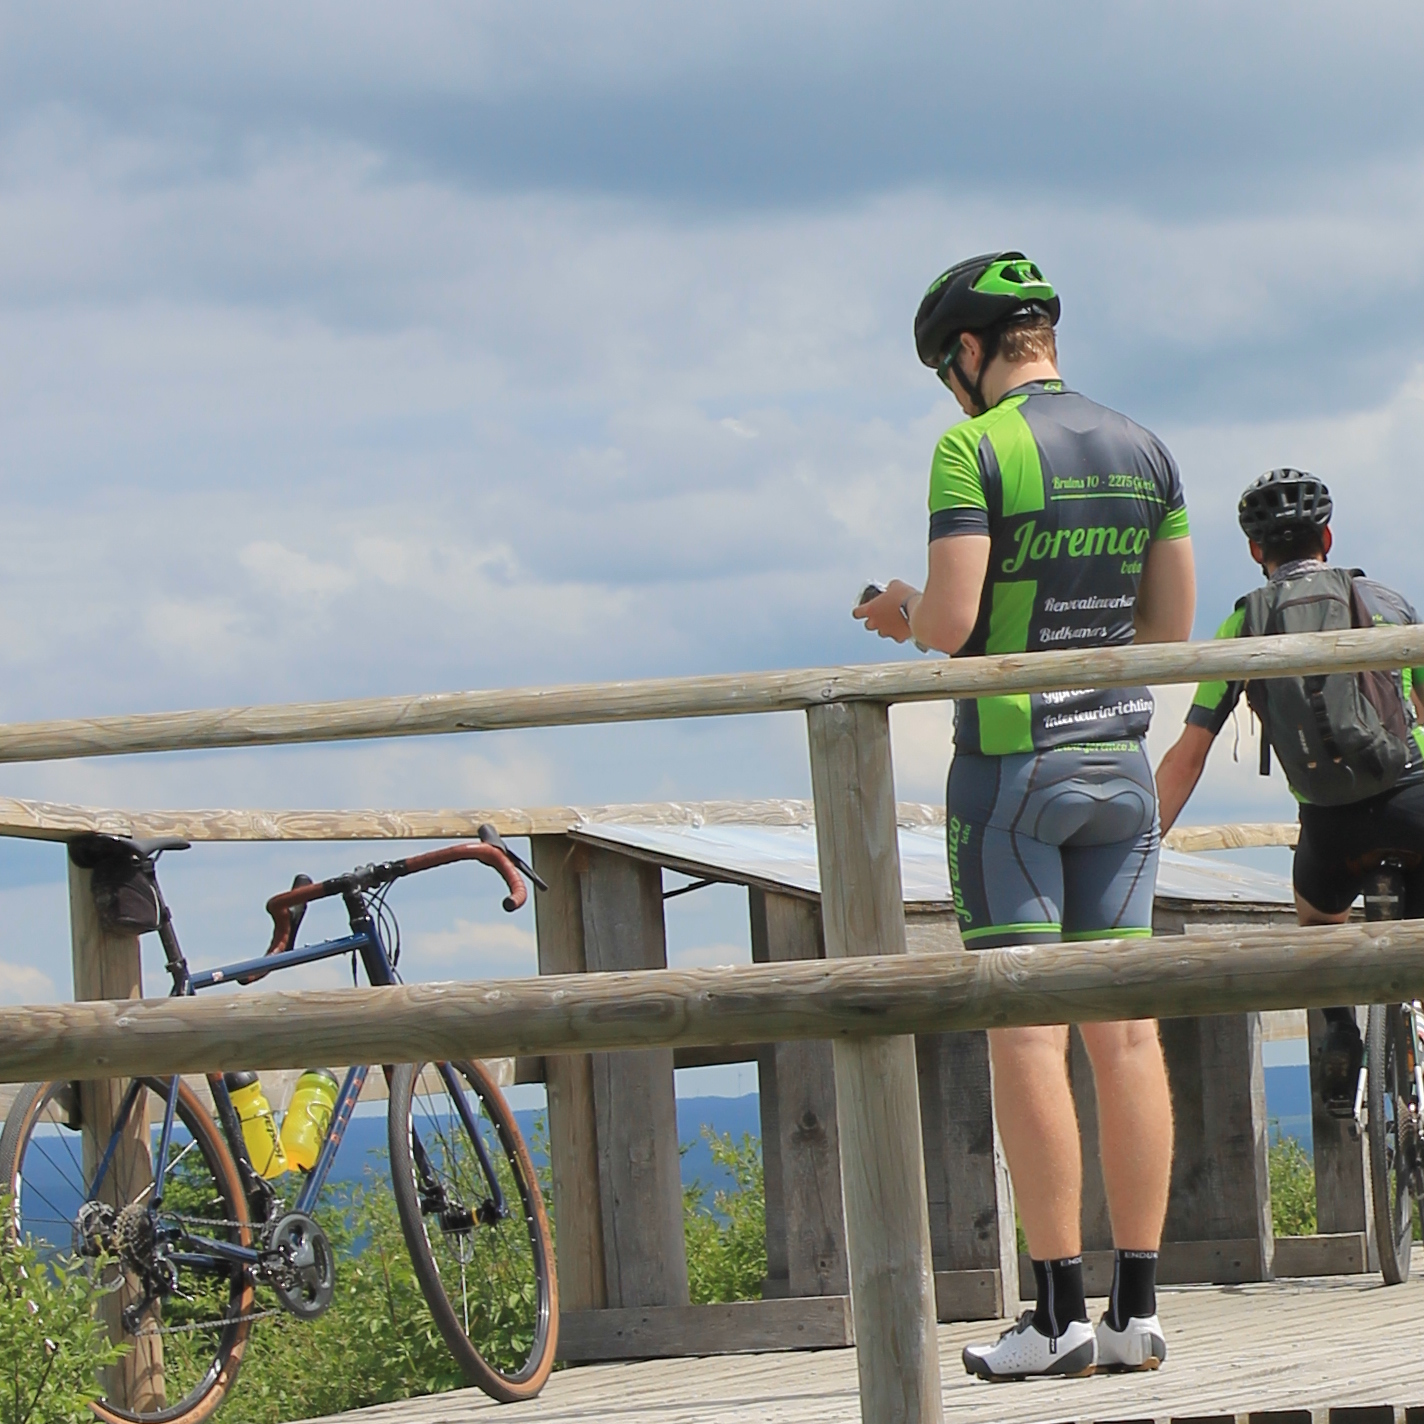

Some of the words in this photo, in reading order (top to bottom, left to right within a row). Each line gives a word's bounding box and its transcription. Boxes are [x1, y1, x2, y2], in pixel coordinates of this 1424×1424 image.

[1087, 475, 1099, 488] 10
[1108, 474, 1132, 487] 2275
[1001, 520, 1150, 574] Joremco
